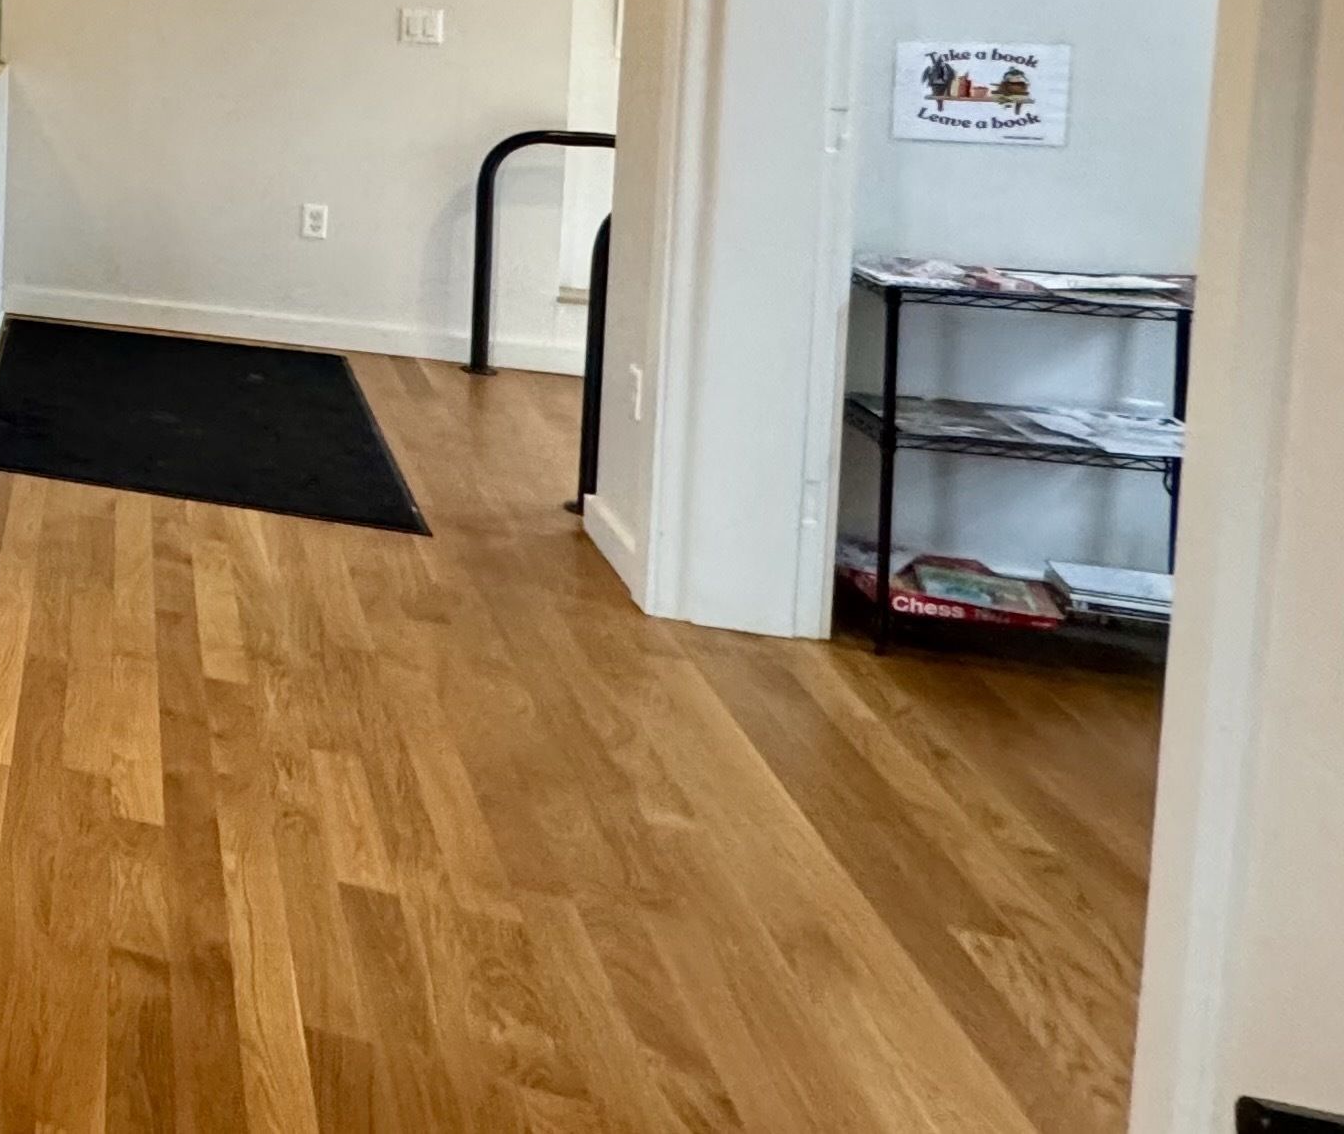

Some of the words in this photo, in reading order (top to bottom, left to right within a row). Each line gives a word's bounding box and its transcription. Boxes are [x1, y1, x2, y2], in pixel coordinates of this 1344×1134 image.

[925, 48, 972, 66] Take
[975, 50, 987, 60] a
[991, 48, 1039, 68] book
[917, 107, 972, 129] Leave
[975, 119, 988, 130] a
[991, 113, 1041, 129] book
[892, 595, 966, 619] Chess
